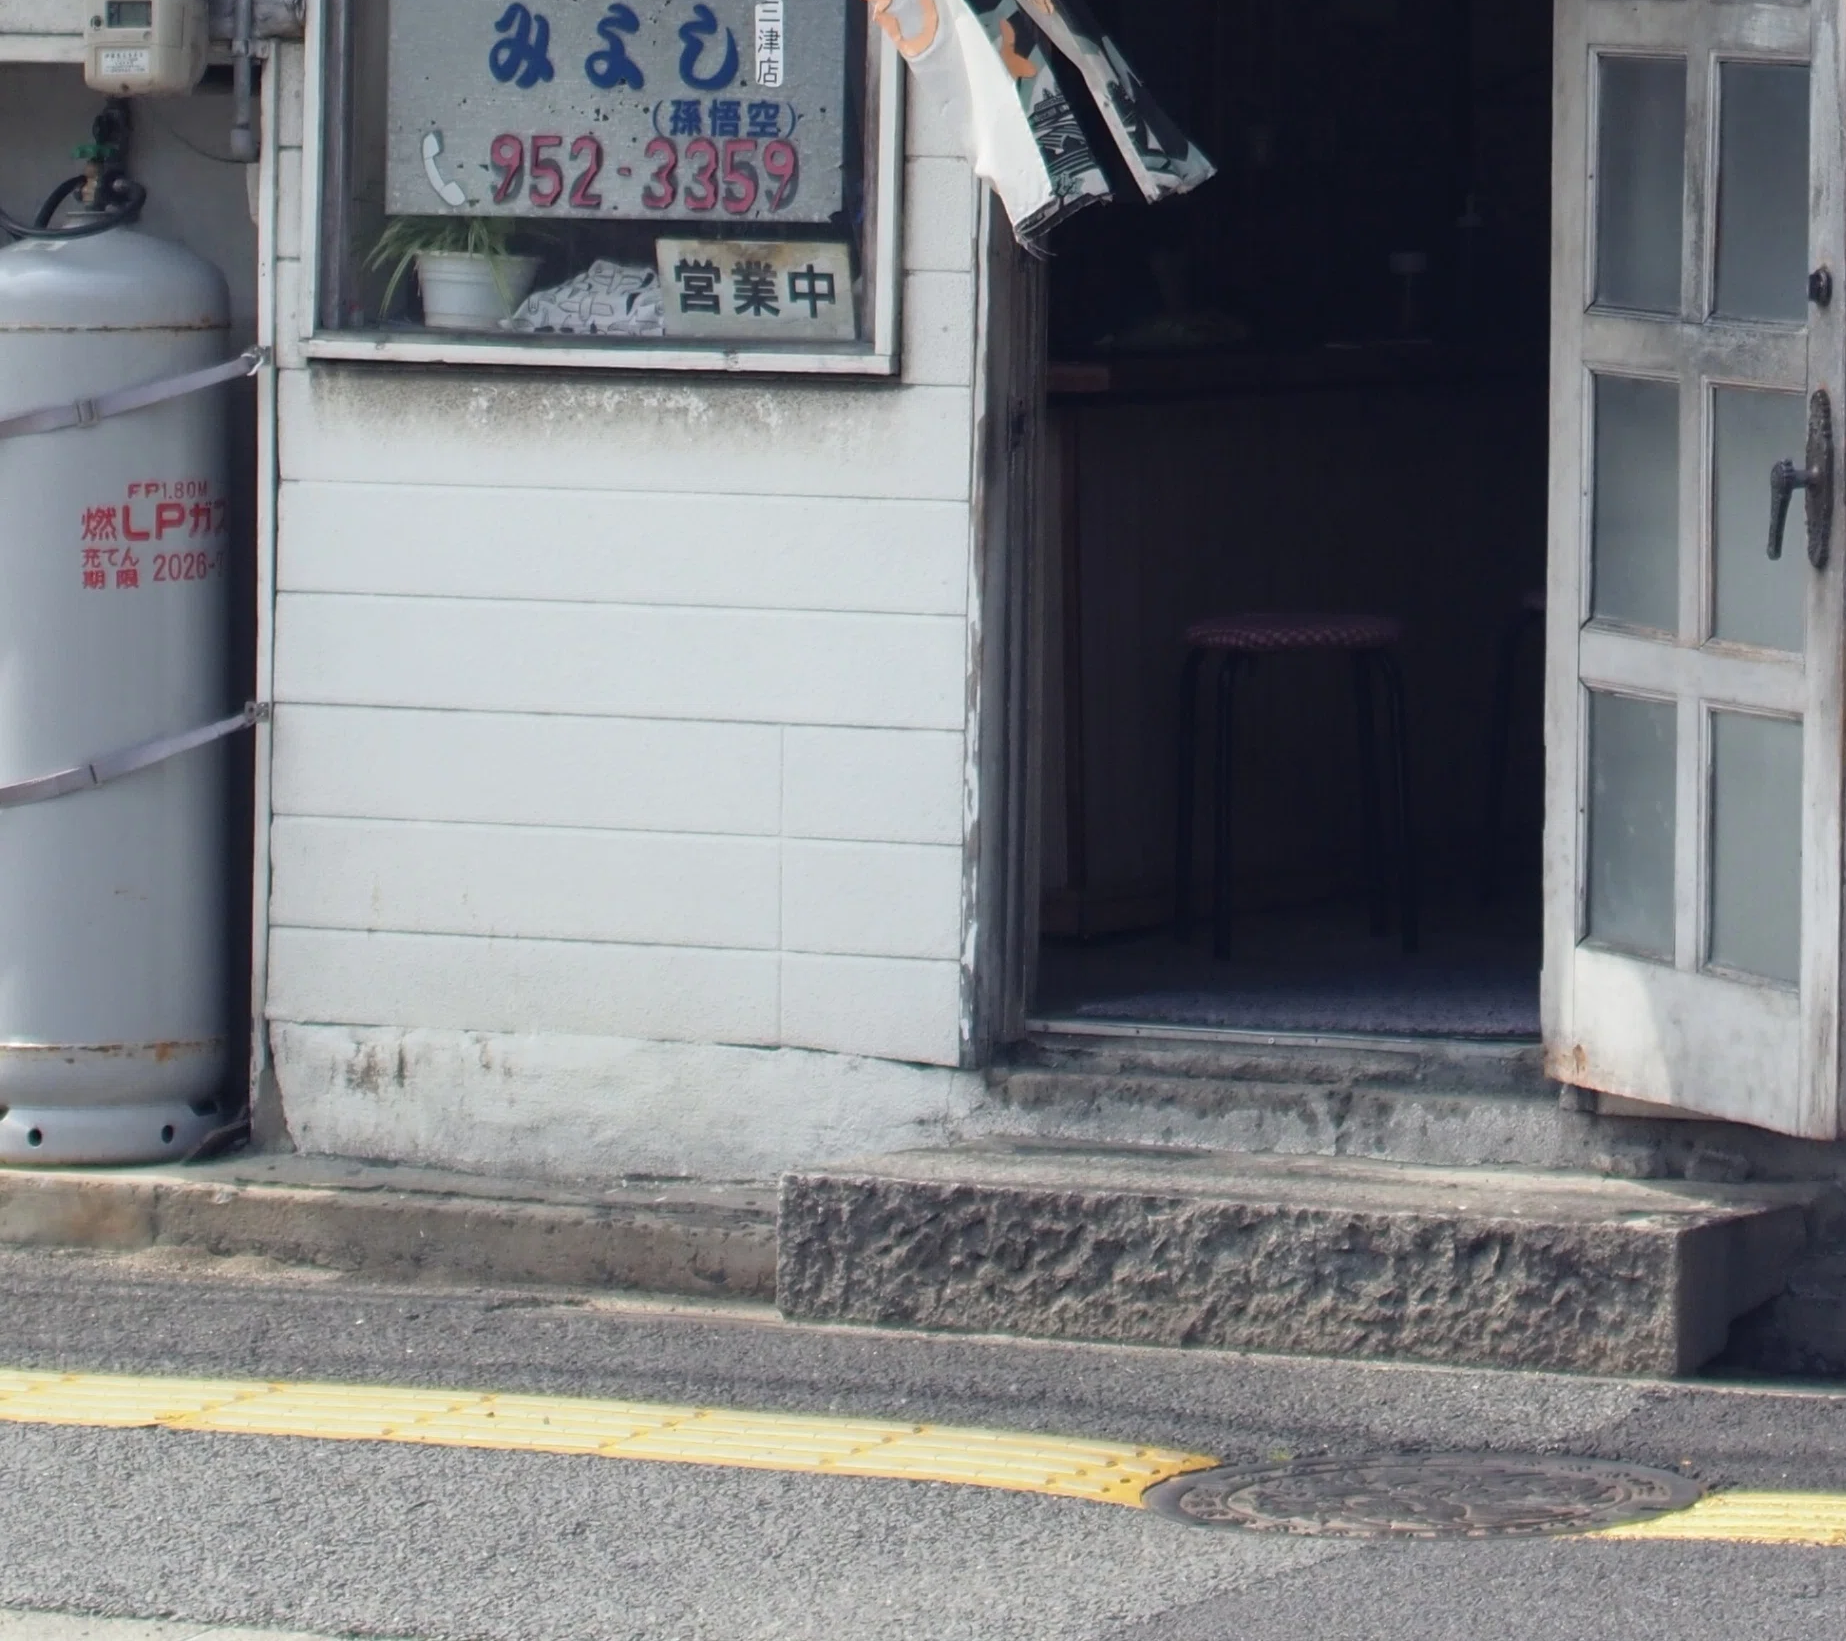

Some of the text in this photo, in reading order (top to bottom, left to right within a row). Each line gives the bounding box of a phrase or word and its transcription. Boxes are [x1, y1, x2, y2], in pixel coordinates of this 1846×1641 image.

[488, 2, 739, 90] みよし
[757, 0, 781, 85] 三津店
[652, 99, 797, 139] (孫悟空)
[490, 133, 800, 213] 952-3359
[673, 257, 838, 319] 営業中
[81, 547, 140, 569] 充てん
[82, 569, 139, 590] 期限
